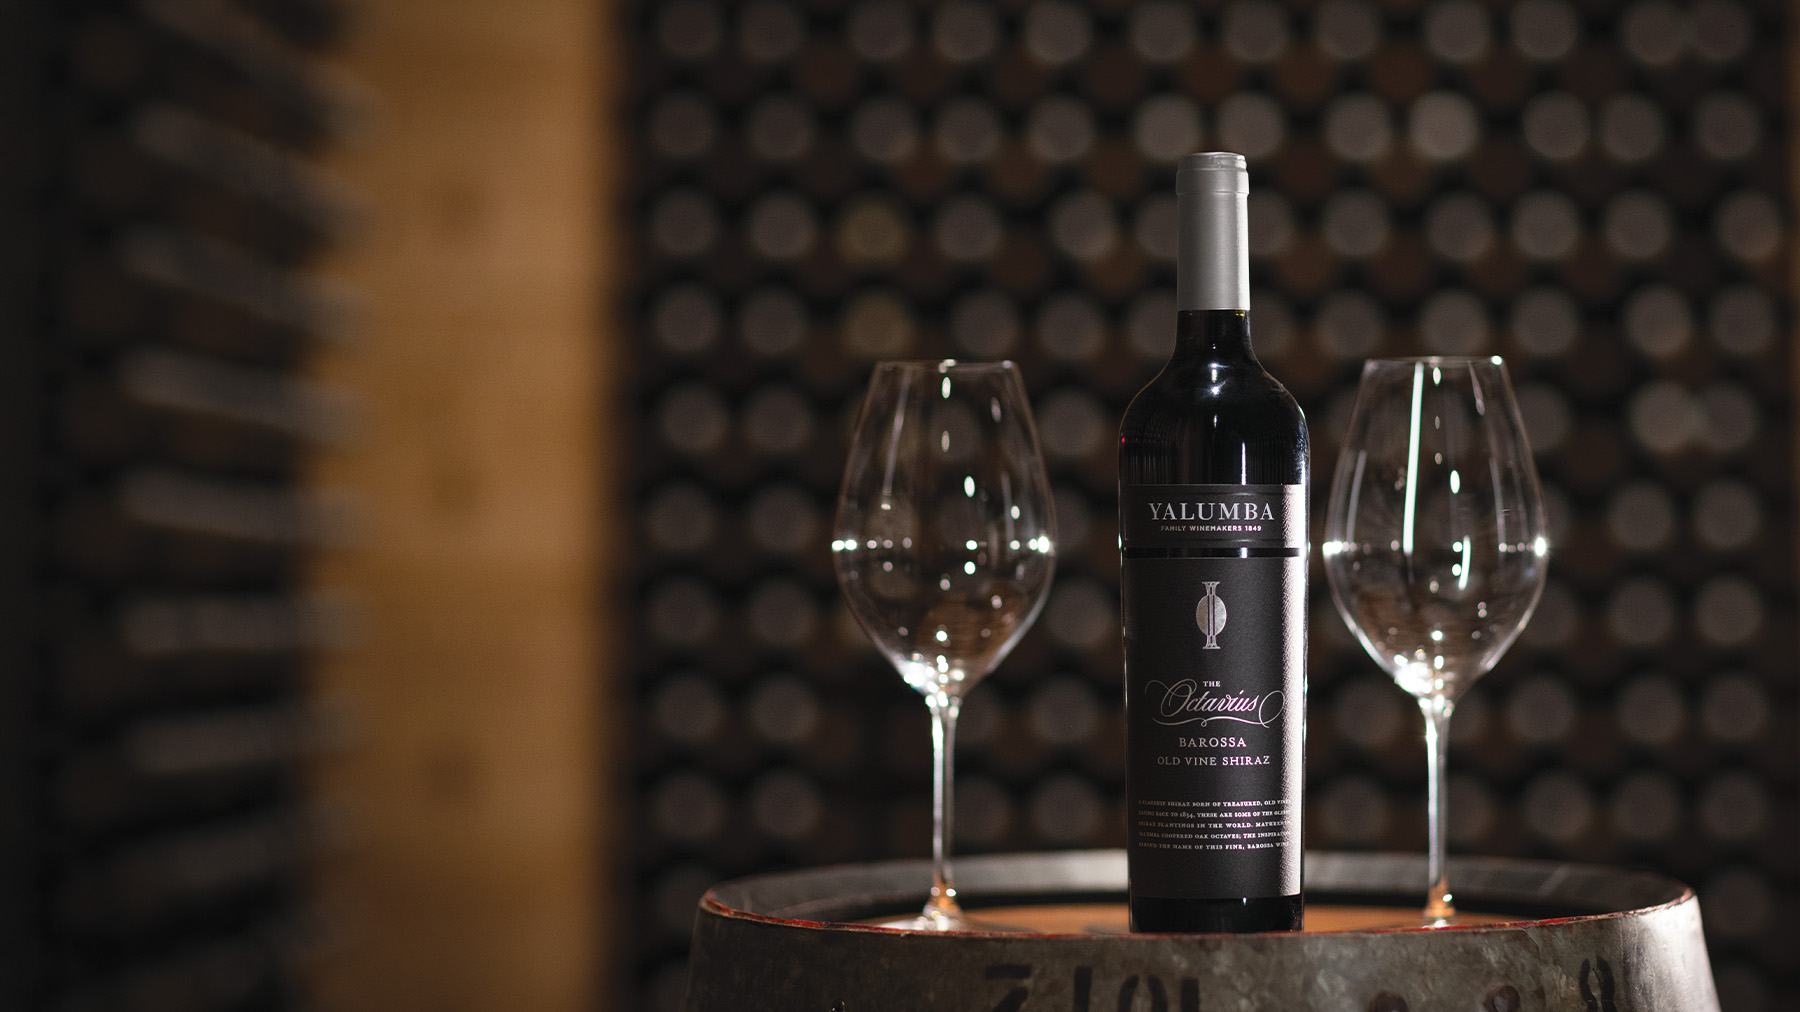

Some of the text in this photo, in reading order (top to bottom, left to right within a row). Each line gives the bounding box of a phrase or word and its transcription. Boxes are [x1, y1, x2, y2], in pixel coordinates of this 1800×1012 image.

[1148, 502, 1274, 520] YALUMBA
[1145, 679, 1260, 718] Octavius
[1179, 737, 1246, 748] BAROSSA
[1157, 755, 1270, 766] OLD VINE SHIRAZ
